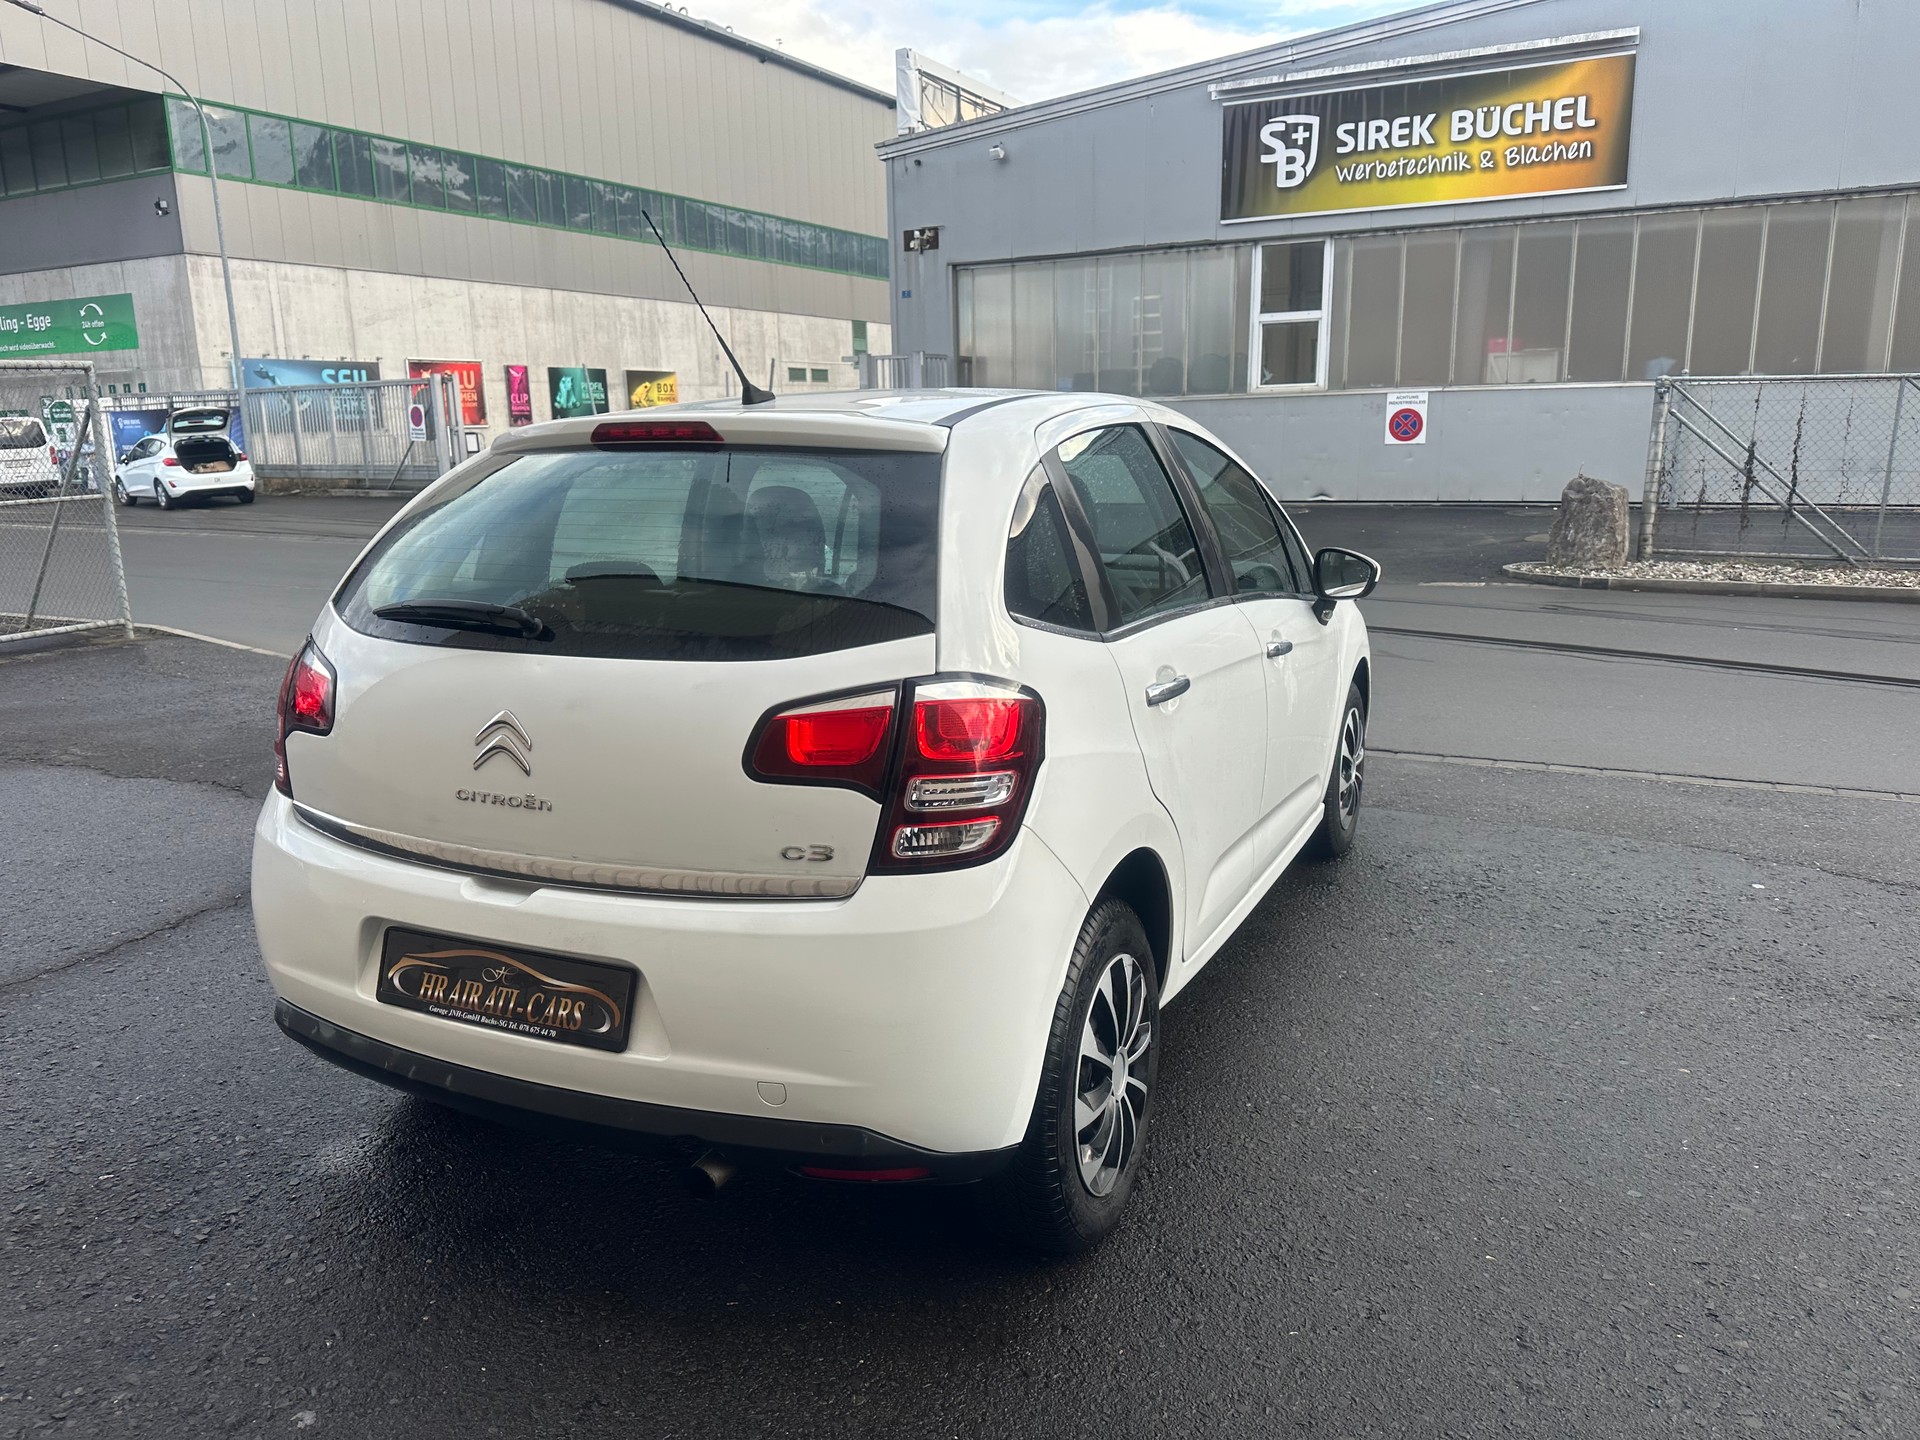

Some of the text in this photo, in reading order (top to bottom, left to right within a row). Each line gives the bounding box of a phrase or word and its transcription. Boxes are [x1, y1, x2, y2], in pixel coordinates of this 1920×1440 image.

[1336, 95, 1596, 154] SIREK BÜCHEL
[1335, 140, 1592, 183] Werbetechnik & Blachen
[26, 313, 52, 332] Egge
[656, 383, 675, 393] BOX
[510, 393, 529, 404] CLIP
[781, 844, 834, 861] C3
[428, 1004, 449, 1015] Garage
[518, 1023, 530, 1032] 078
[529, 1025, 540, 1034] 675
[540, 1027, 549, 1036] 44
